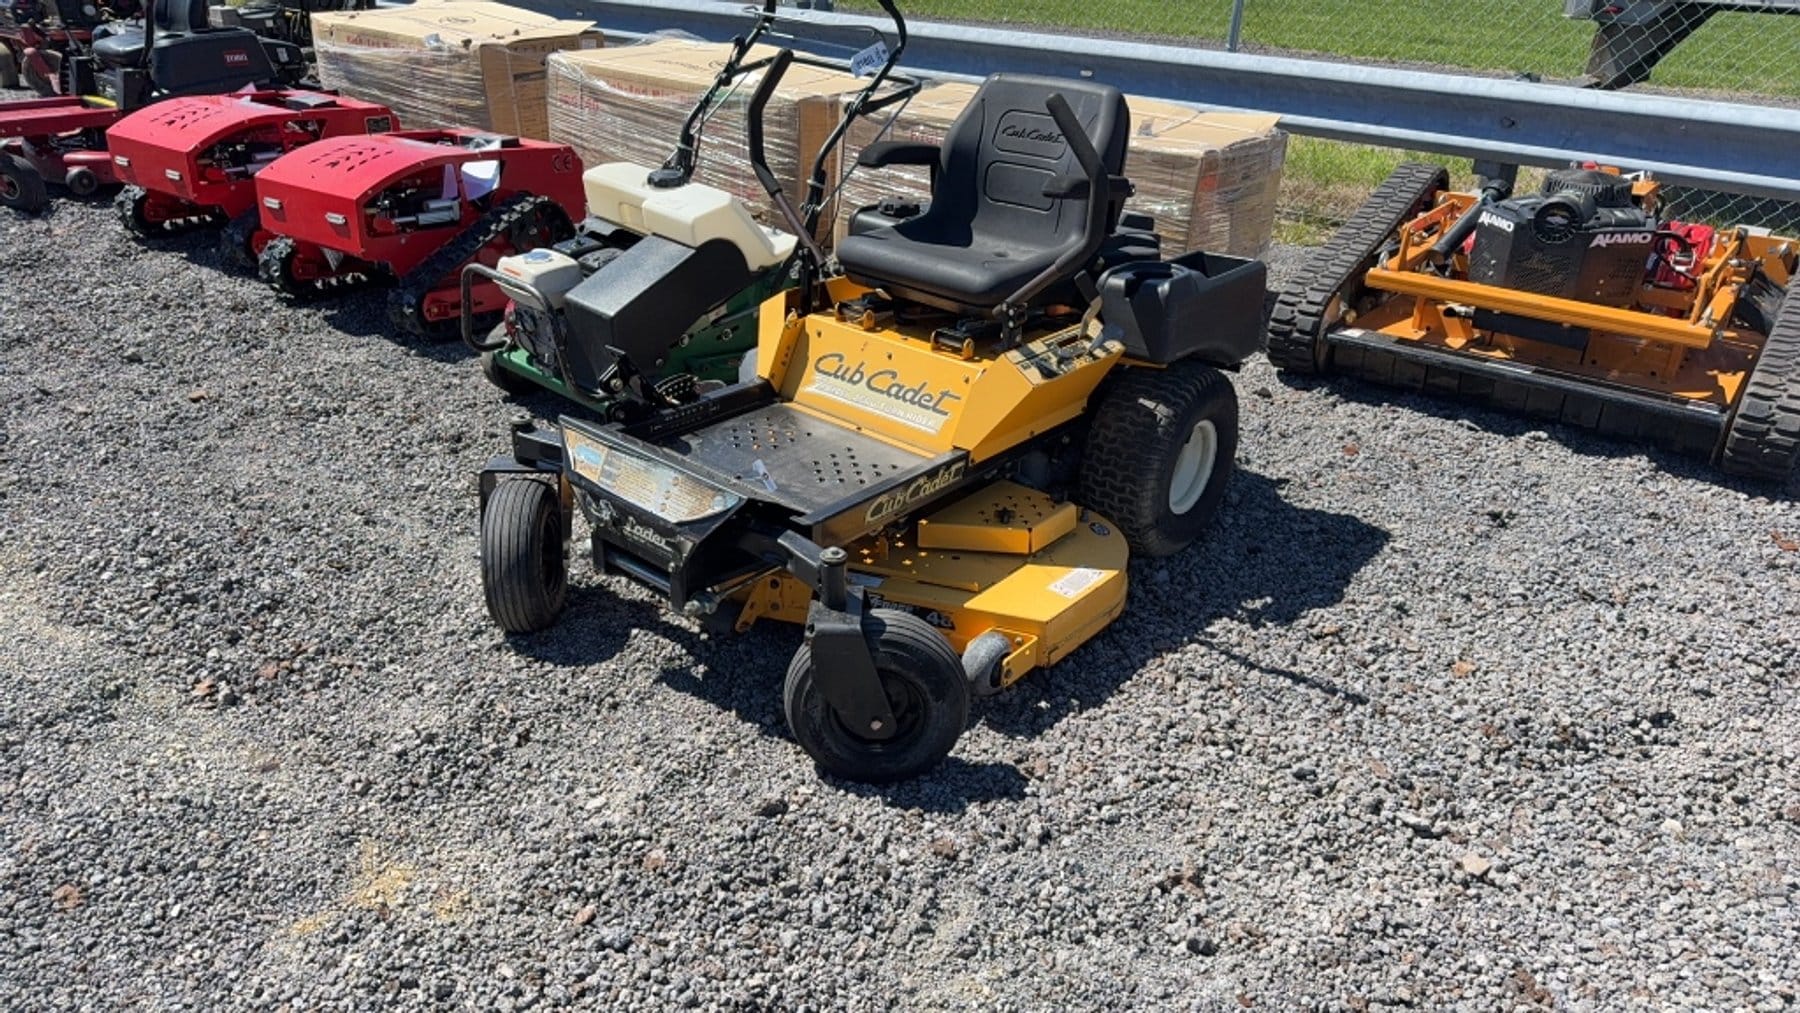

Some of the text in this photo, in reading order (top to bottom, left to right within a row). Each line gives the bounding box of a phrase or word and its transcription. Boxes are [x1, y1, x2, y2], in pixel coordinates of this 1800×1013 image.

[224, 54, 248, 63] TORO
[1001, 124, 1064, 144] Cub Cadet
[1478, 210, 1515, 233] ALAMO
[1589, 231, 1653, 249] ALAMO
[813, 352, 865, 386] Cub
[865, 368, 961, 416] Cadet
[864, 461, 966, 525] Cub Cadet
